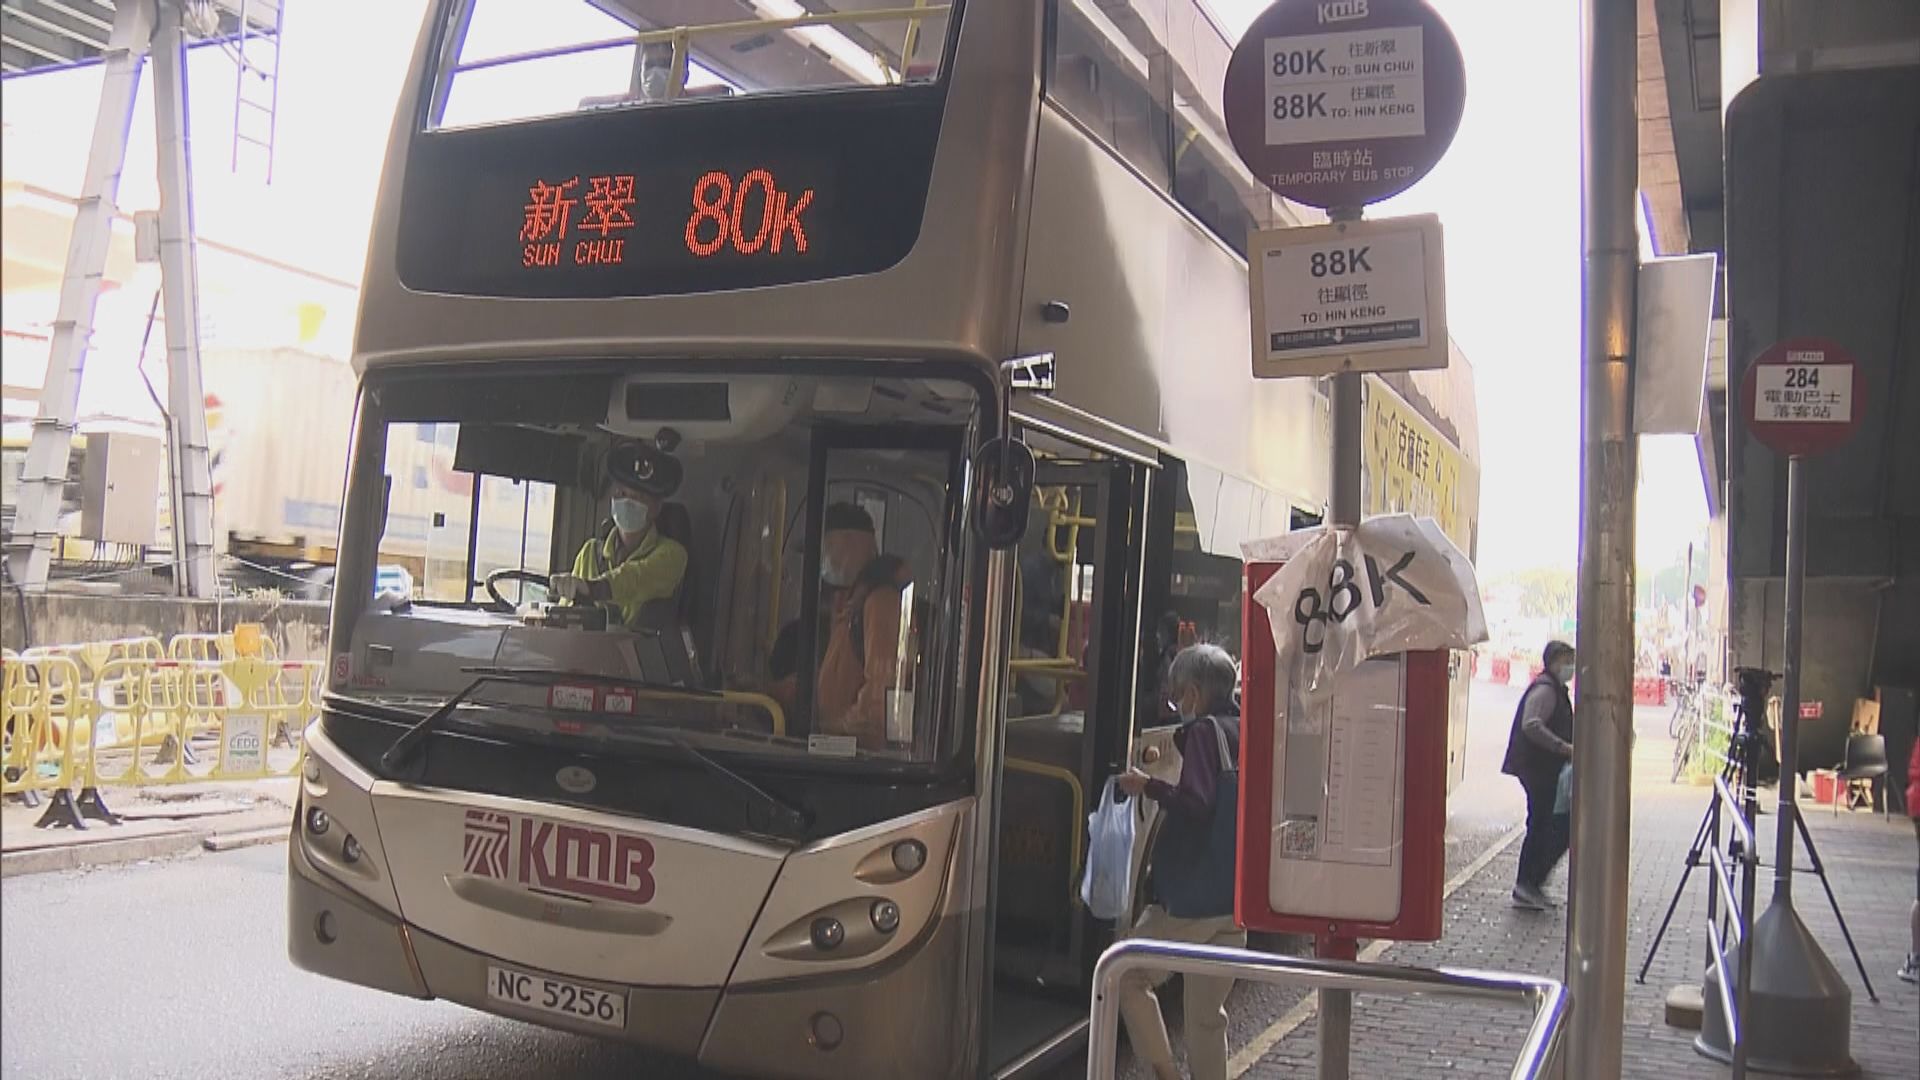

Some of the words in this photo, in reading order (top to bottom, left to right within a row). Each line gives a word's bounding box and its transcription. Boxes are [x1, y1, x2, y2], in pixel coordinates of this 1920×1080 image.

[1318, 0, 1369, 24] KMB
[1349, 39, 1396, 58] 往新翠
[1272, 48, 1327, 77] 80K
[1331, 65, 1350, 77] TO:
[1354, 63, 1380, 75] SUN
[1384, 60, 1414, 73] CHUI
[1272, 92, 1327, 120] 88K
[1332, 107, 1350, 119] TO:
[1354, 105, 1376, 117] HIN
[1380, 103, 1415, 116] KENG
[1312, 149, 1373, 170] 臨時站
[1271, 170, 1346, 185] TEMPORARY
[1352, 168, 1377, 181] BUS
[1384, 166, 1414, 180] STOP
[519, 174, 636, 242] 新翠
[684, 168, 815, 257] 80K
[522, 241, 560, 267] SUN
[574, 239, 625, 264] CHUI
[1311, 246, 1372, 278] 88K
[1301, 312, 1322, 325] TO:
[1326, 308, 1347, 321] HIN
[1350, 305, 1386, 319] KENG
[1784, 367, 1819, 388] 284
[1763, 389, 1841, 404] 電動巴士
[1294, 551, 1432, 654] 88K
[230, 736, 259, 750] CEDD
[518, 818, 656, 905] KMB
[497, 971, 531, 1001] NC
[543, 982, 614, 1021] 5256
